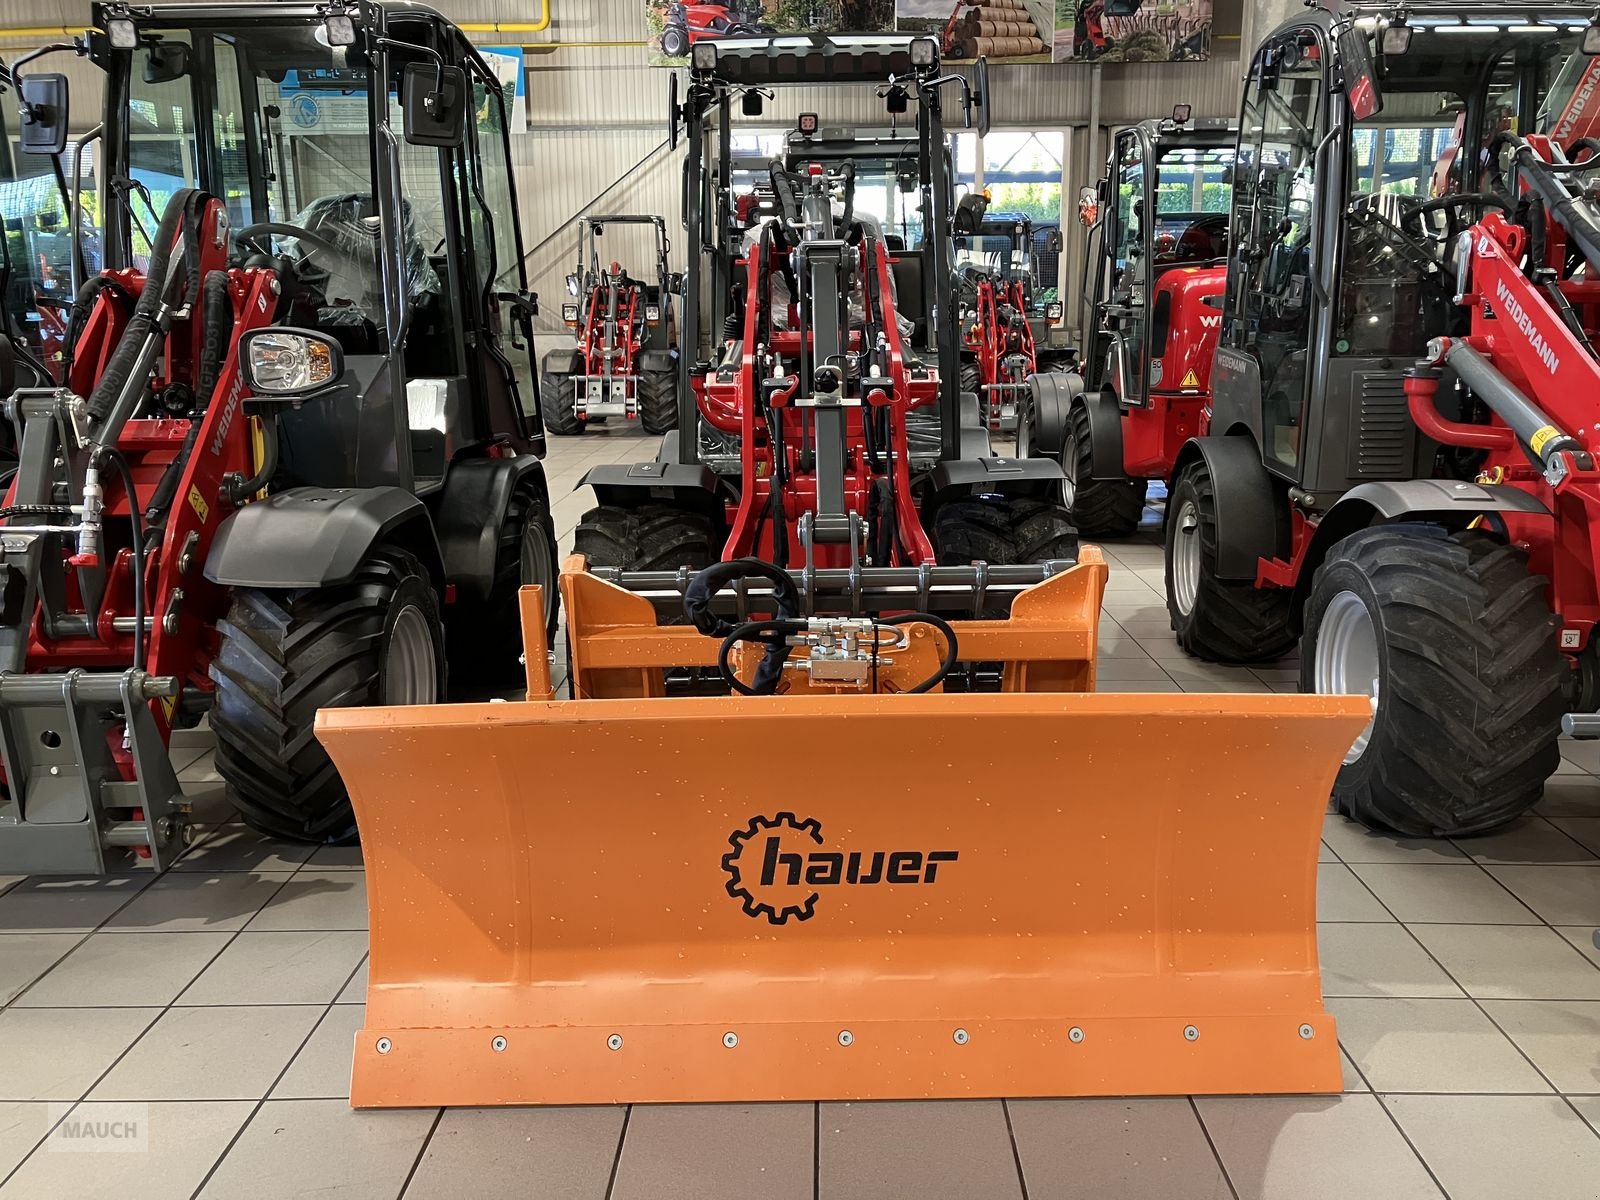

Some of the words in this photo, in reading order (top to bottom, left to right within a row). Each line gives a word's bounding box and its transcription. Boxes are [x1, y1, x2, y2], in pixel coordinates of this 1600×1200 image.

[1556, 61, 1600, 138] WEIDEMA
[1496, 277, 1559, 375] WEIDEMANN
[760, 837, 959, 885] hauer
